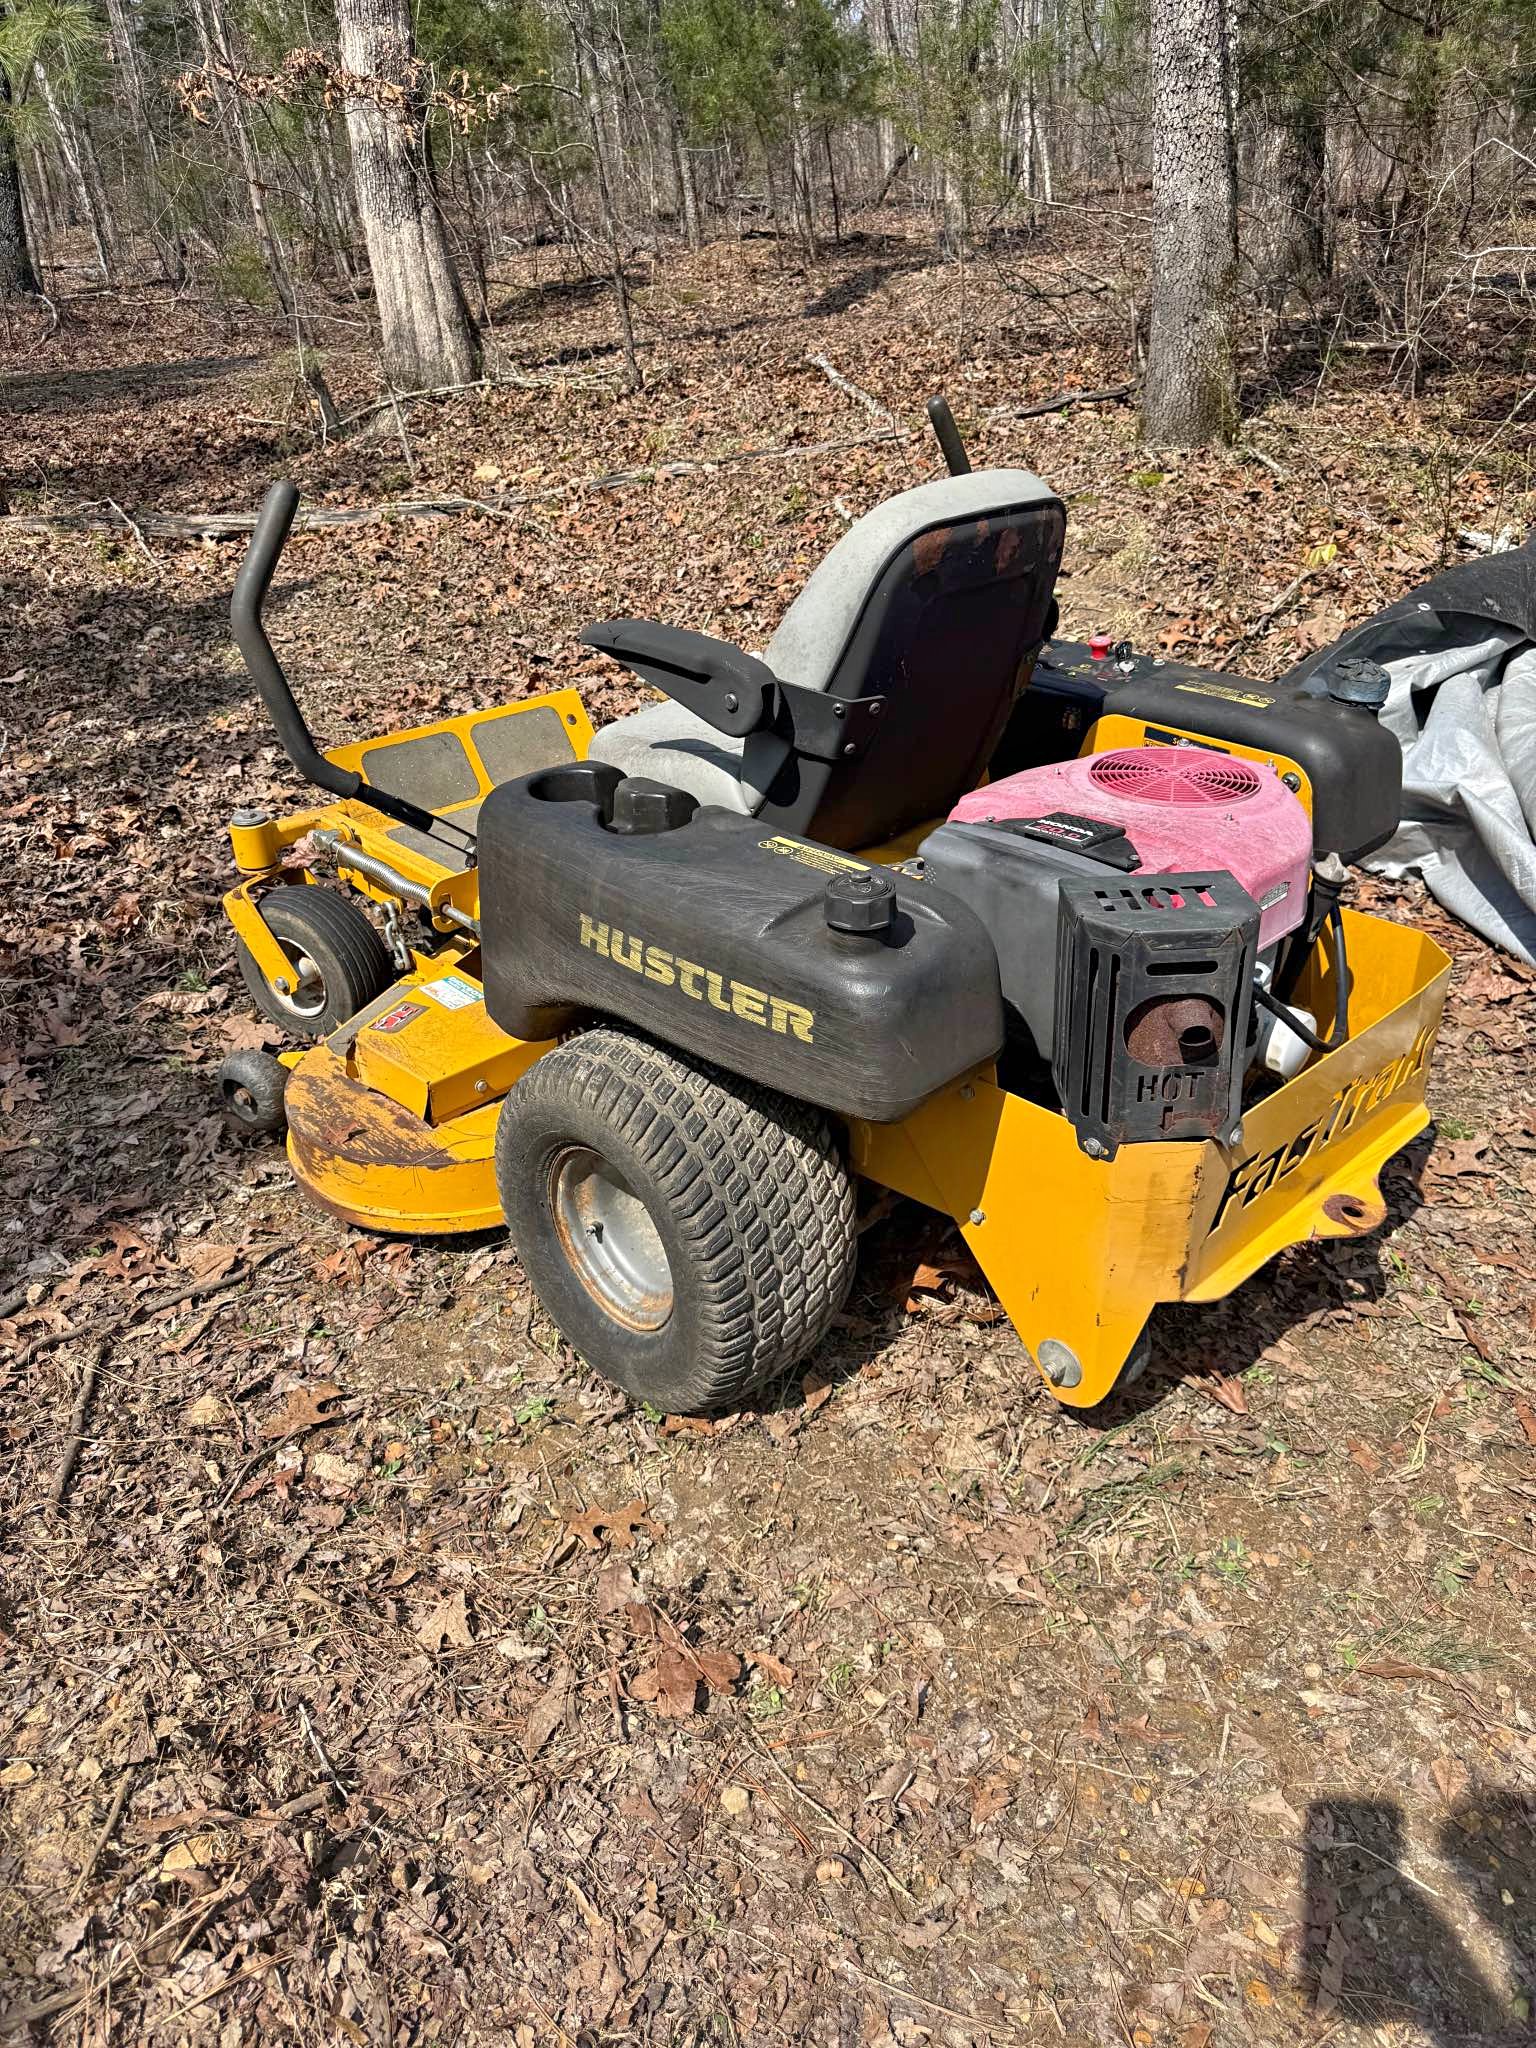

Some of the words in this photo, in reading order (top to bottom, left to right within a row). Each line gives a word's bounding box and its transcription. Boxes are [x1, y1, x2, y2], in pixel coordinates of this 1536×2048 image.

[1094, 884, 1218, 912] HOT
[579, 912, 815, 1044] HUSTLER
[1137, 1071, 1205, 1103] HOT
